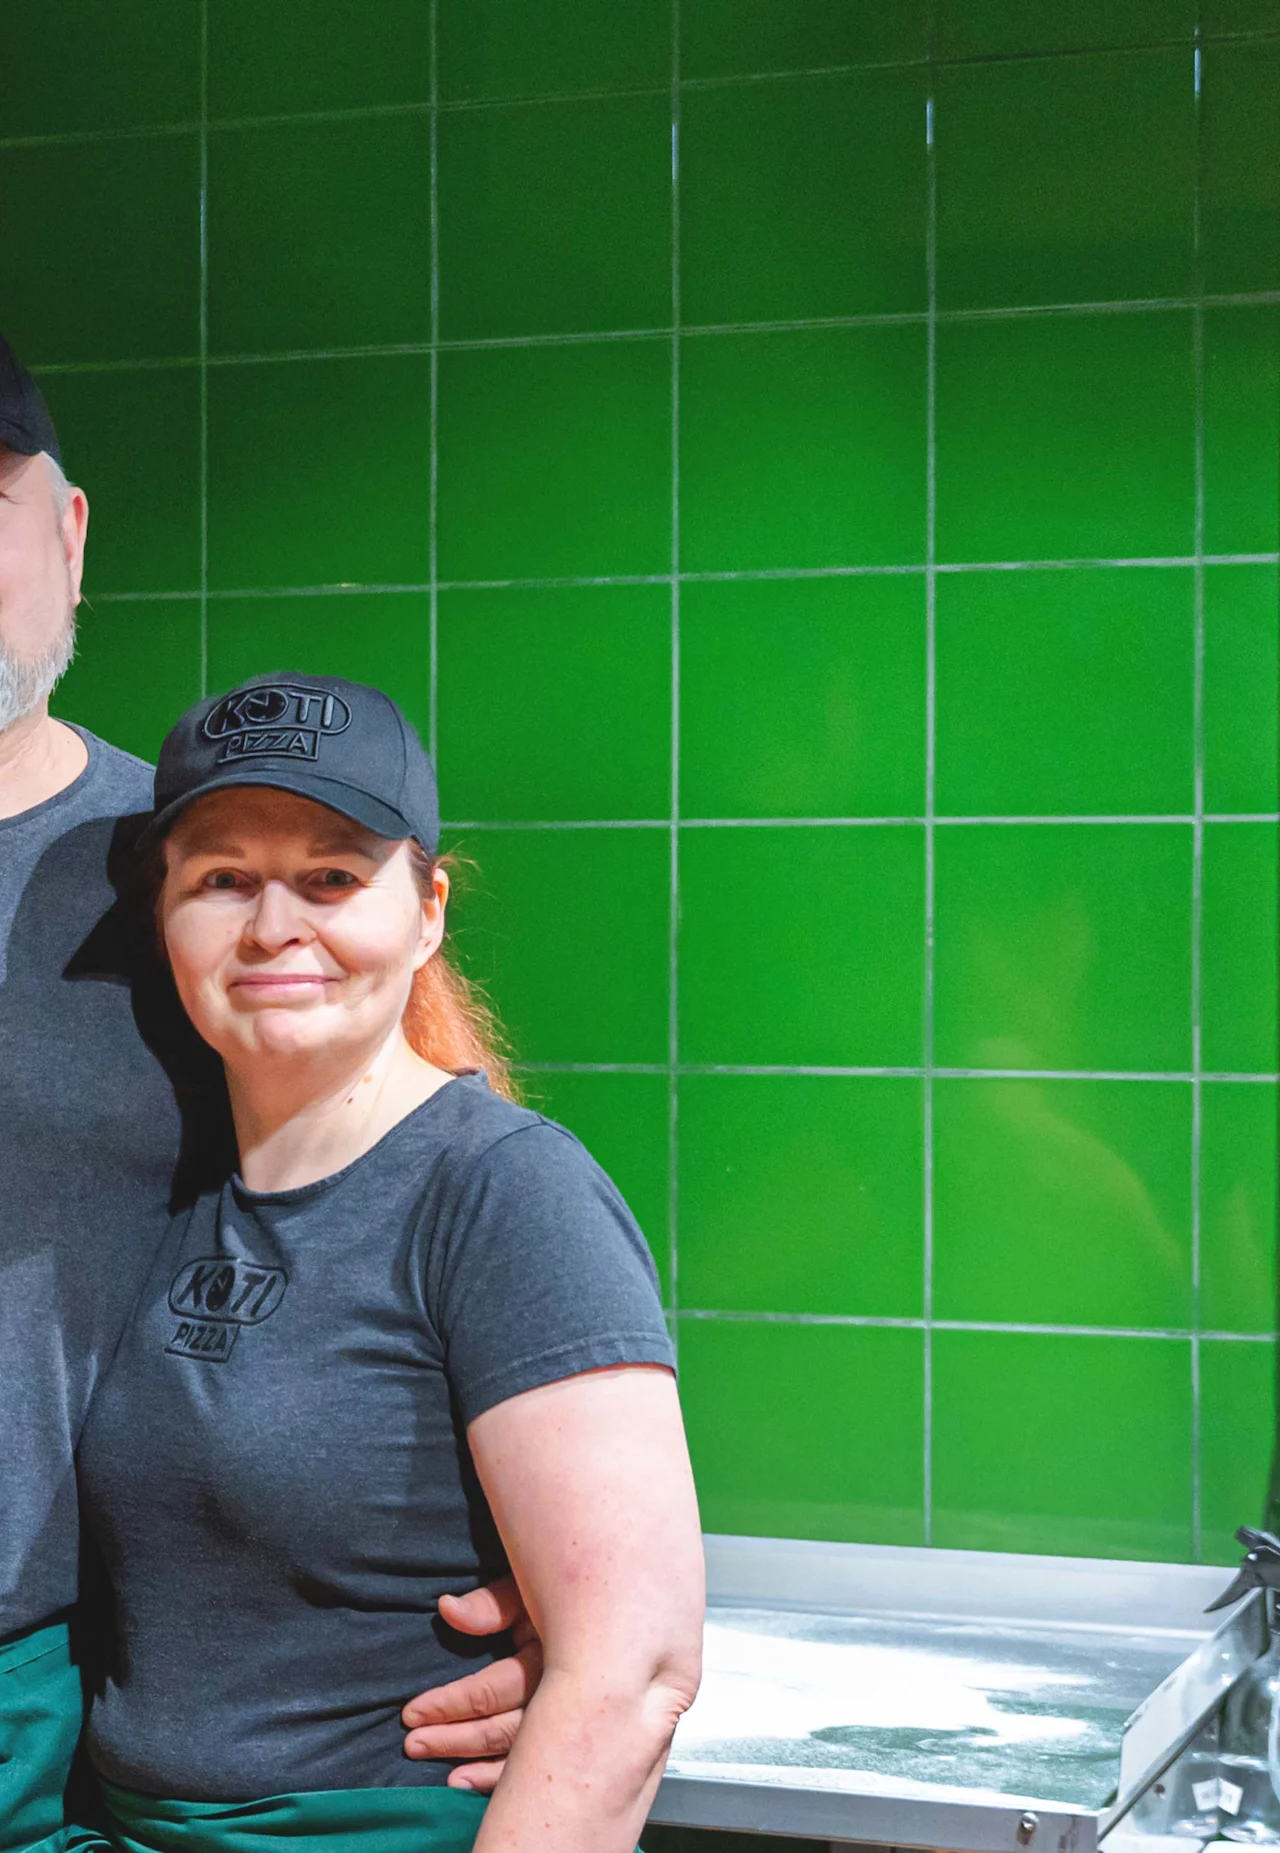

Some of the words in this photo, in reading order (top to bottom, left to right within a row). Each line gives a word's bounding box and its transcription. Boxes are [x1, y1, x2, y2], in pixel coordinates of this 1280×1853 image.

[226, 731, 308, 757] PIZZA
[177, 1264, 277, 1317] KOTI
[171, 1322, 227, 1352] PIZZA
